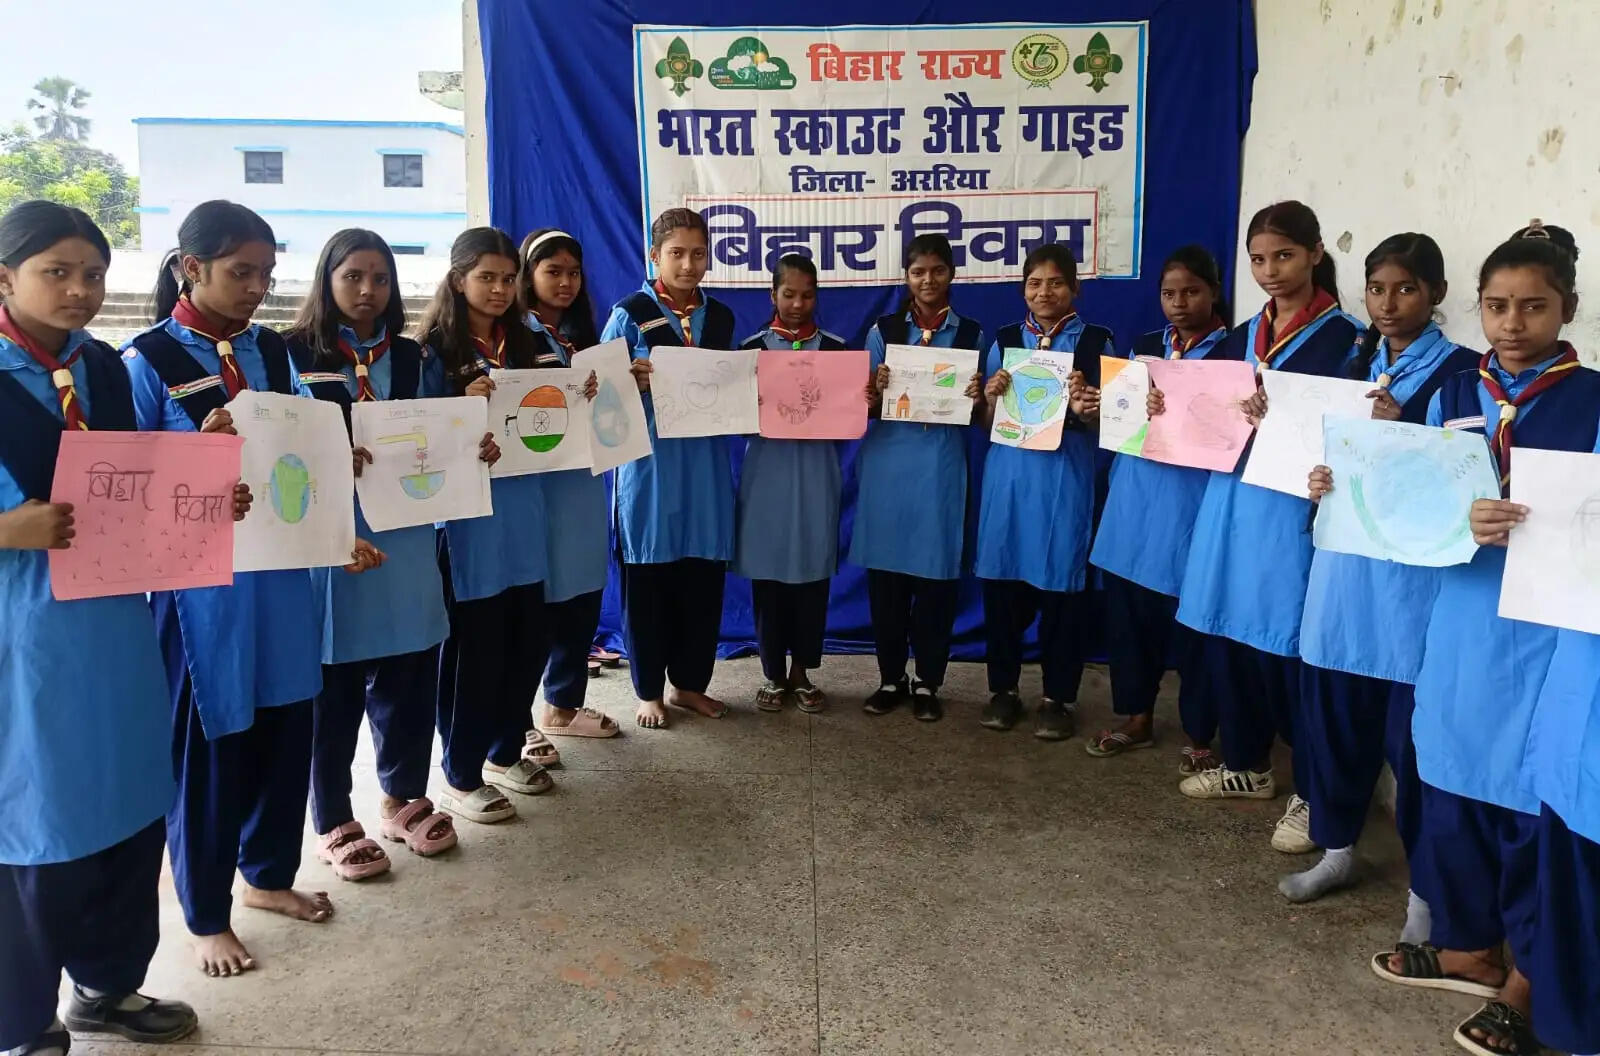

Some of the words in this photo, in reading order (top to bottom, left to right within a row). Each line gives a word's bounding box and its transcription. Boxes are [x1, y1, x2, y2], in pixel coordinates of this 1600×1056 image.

[806, 43, 904, 82] बिहार
[917, 48, 1006, 80] राज्य
[657, 109, 757, 156] भारत
[771, 108, 905, 156] स्काउट
[923, 92, 1005, 153] और
[1019, 105, 1129, 158] गाइड
[790, 165, 875, 193] जिला-
[891, 164, 990, 190] अररिया
[701, 204, 884, 272] बिहार
[85, 461, 155, 512] बिहार
[170, 483, 226, 525] दिवस
